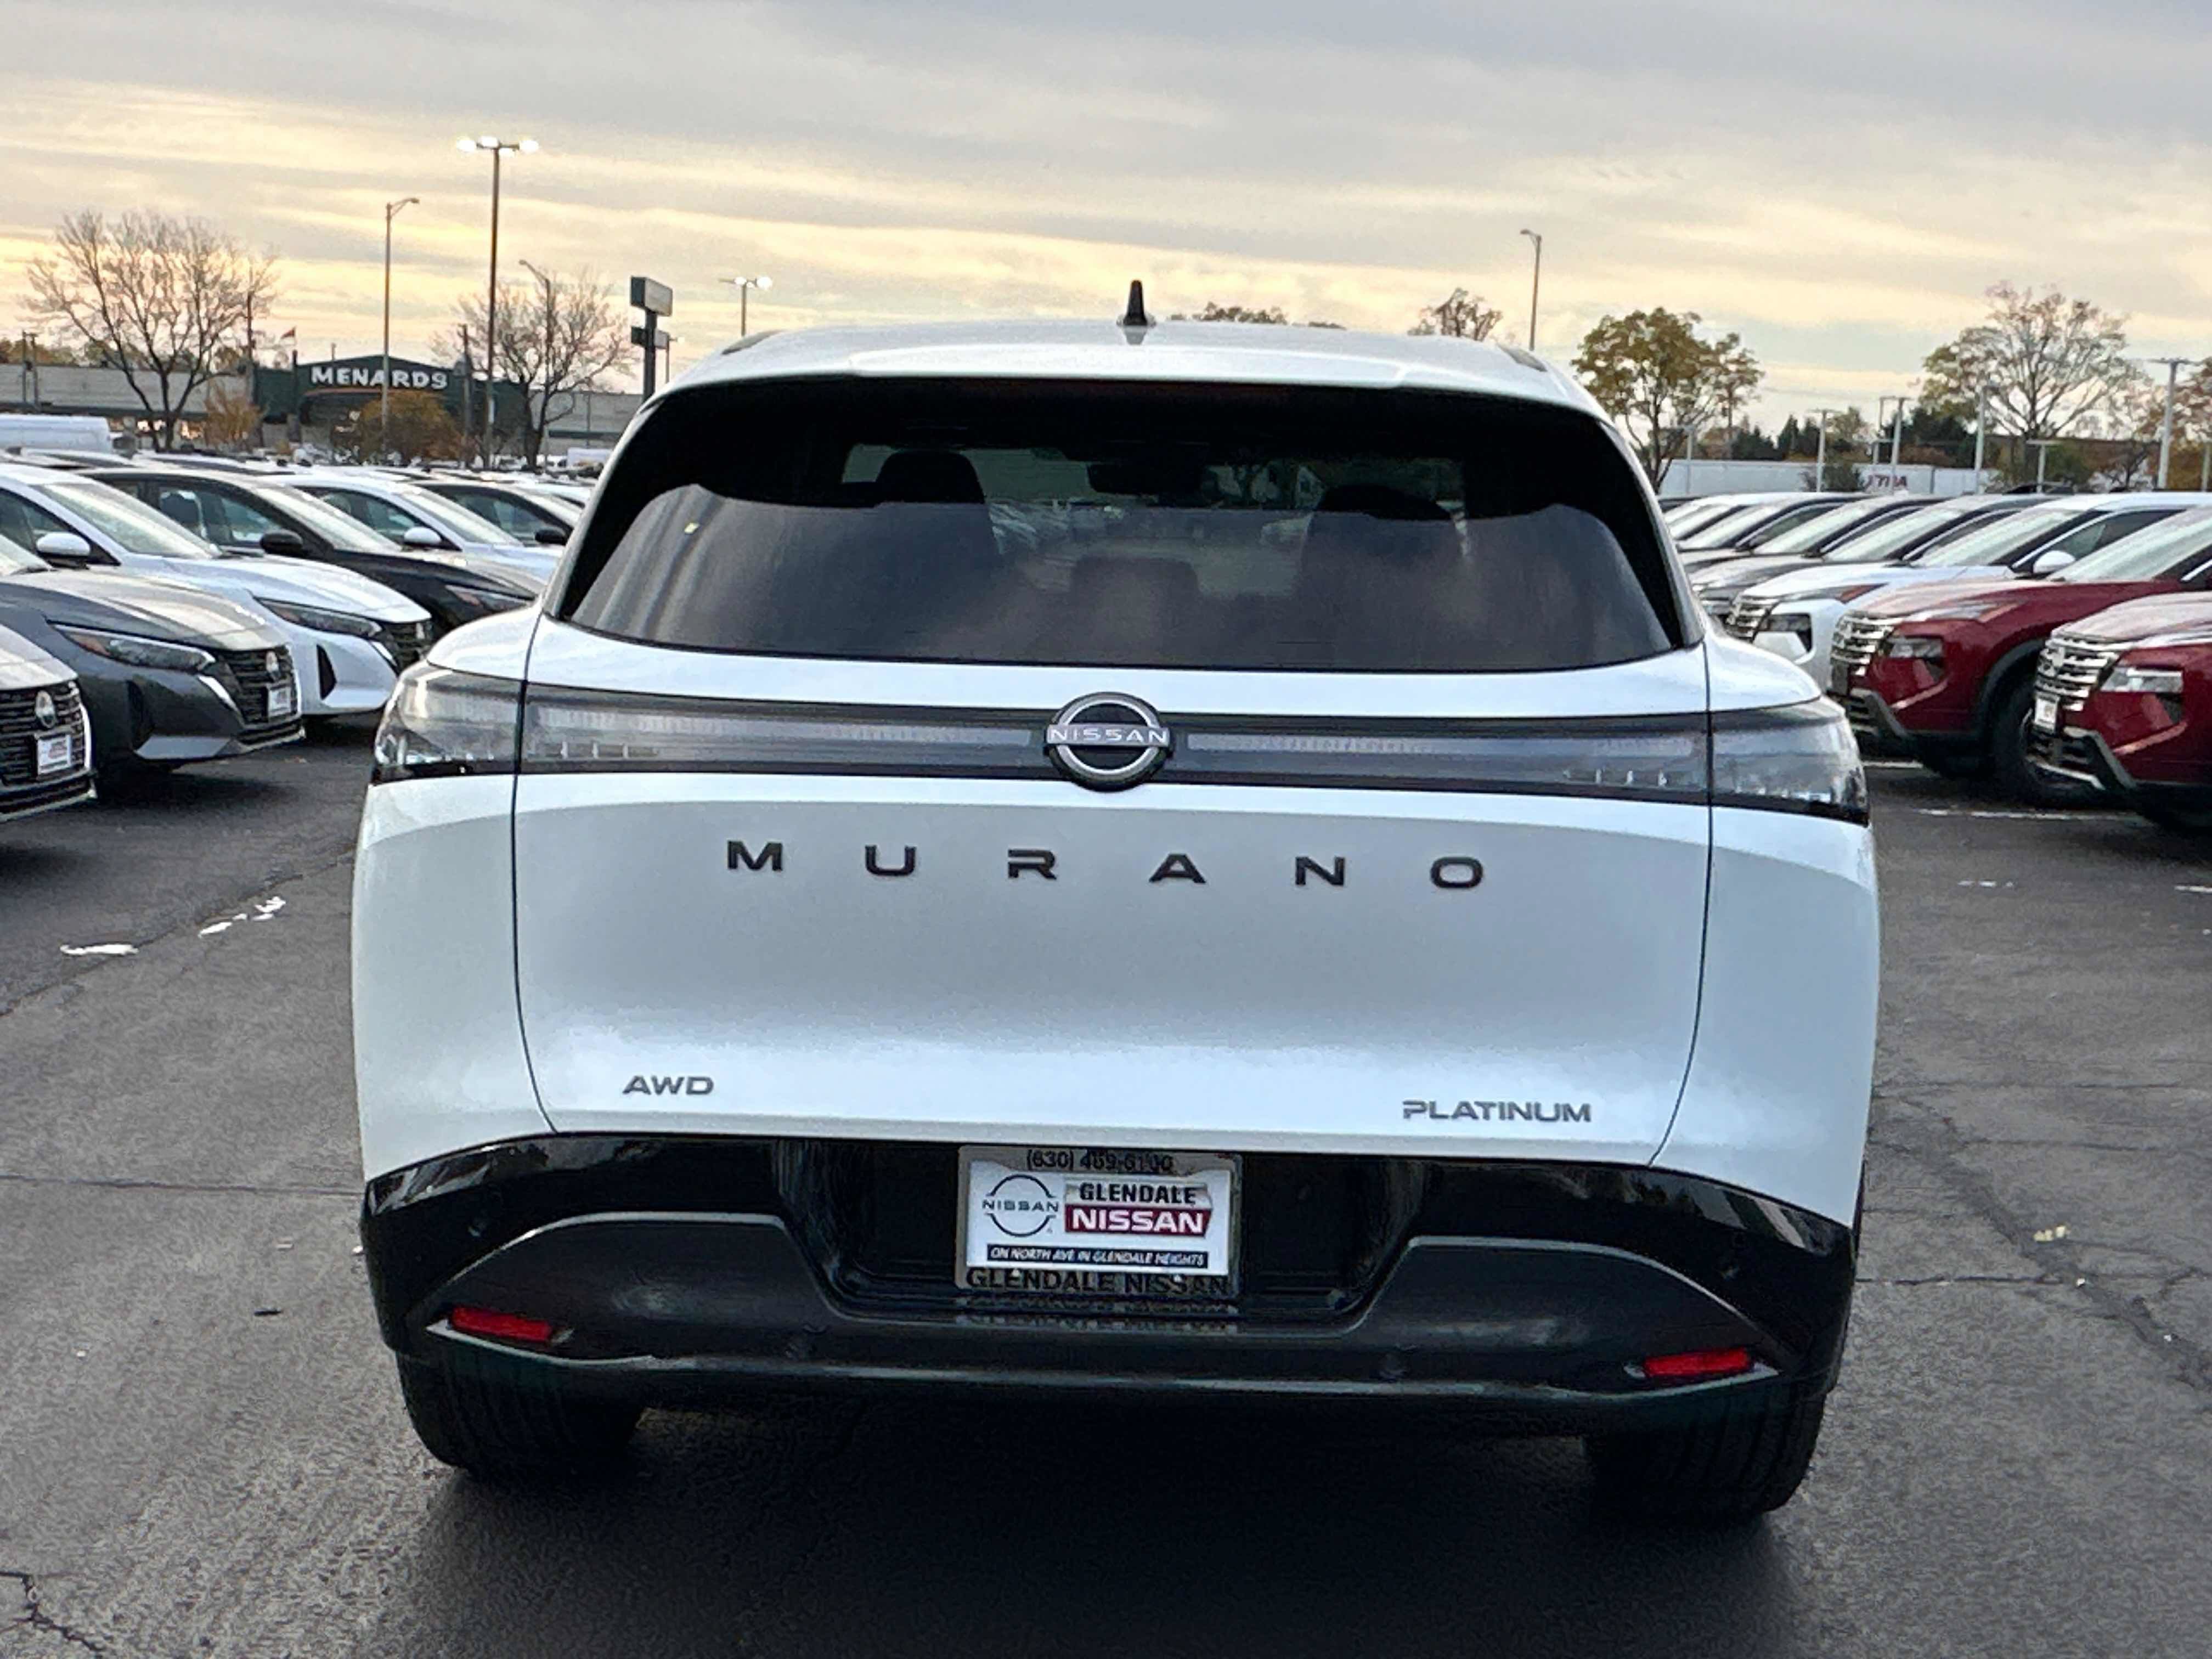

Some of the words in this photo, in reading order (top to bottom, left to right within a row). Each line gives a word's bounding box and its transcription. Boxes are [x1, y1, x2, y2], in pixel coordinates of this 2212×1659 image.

[311, 366, 448, 390] MENARDS
[1049, 727, 1167, 744] NISSAN
[727, 840, 1483, 888] MURANO
[622, 1075, 714, 1095] AWD
[1402, 1100, 1592, 1123] PLATINUM
[1026, 1149, 1074, 1171] (630)
[1080, 1182, 1196, 1205] GLENDALE
[982, 1199, 1058, 1212] NISSAN
[1072, 1207, 1204, 1234] NISSAN
[990, 1247, 1009, 1259] ON
[966, 1268, 1116, 1293] GLENDALE
[1124, 1273, 1229, 1295] NISSAN
